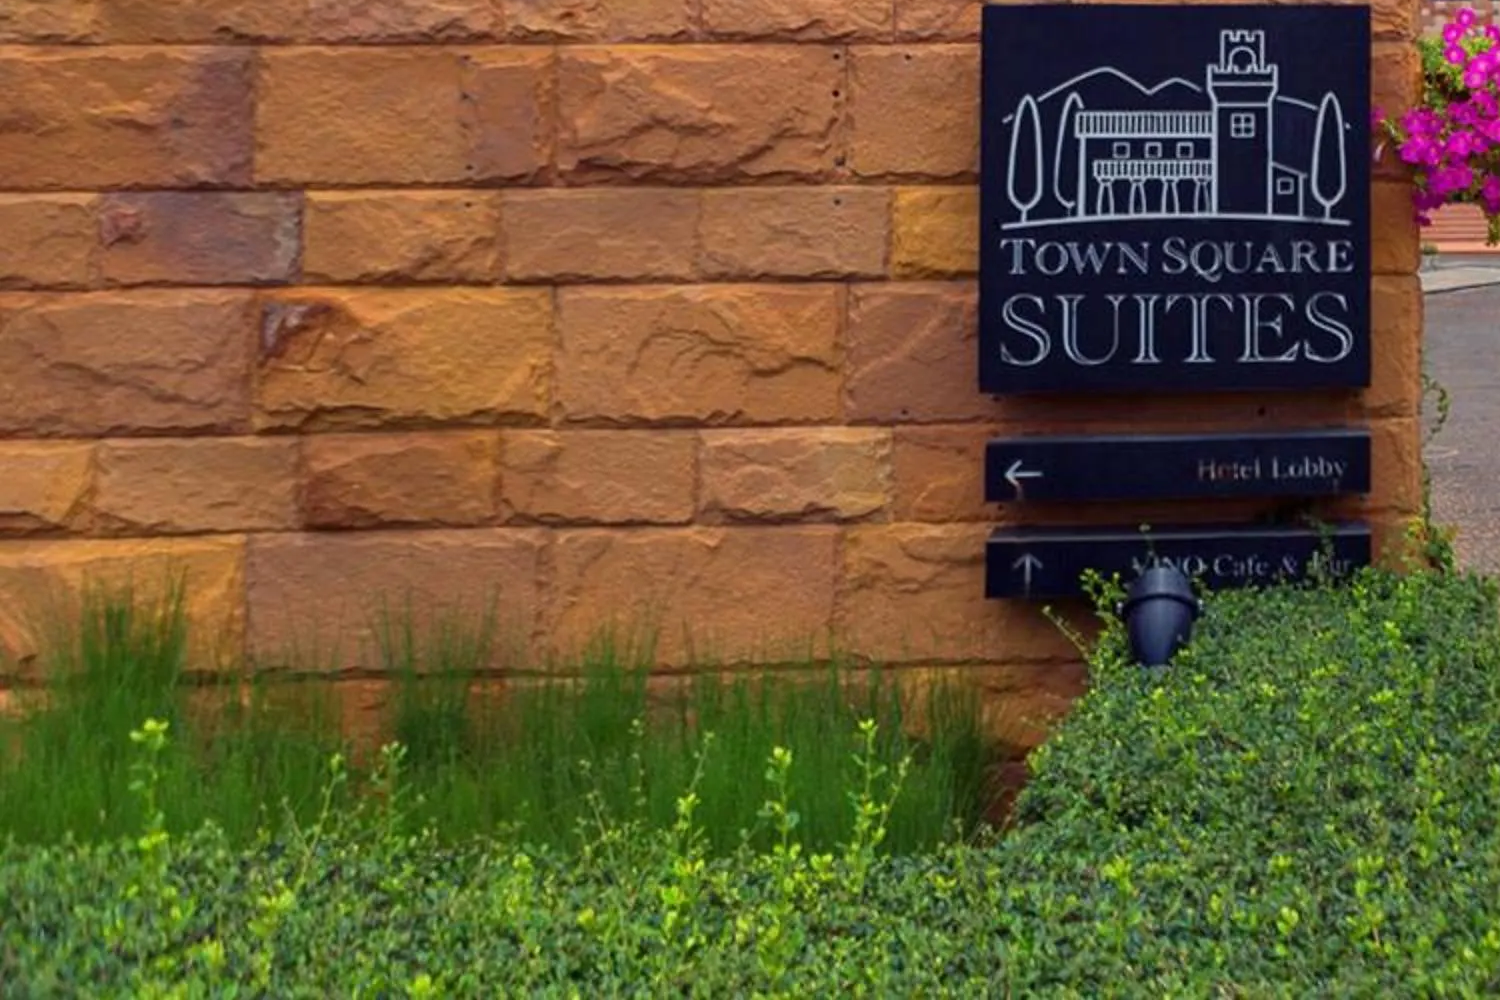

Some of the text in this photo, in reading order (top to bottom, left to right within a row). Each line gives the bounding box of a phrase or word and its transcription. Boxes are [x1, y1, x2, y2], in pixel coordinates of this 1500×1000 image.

[1000, 236, 1355, 282] TOWN SQUARE
[1001, 293, 1354, 366] SUITES
[1198, 456, 1347, 484] Hotel Lobby
